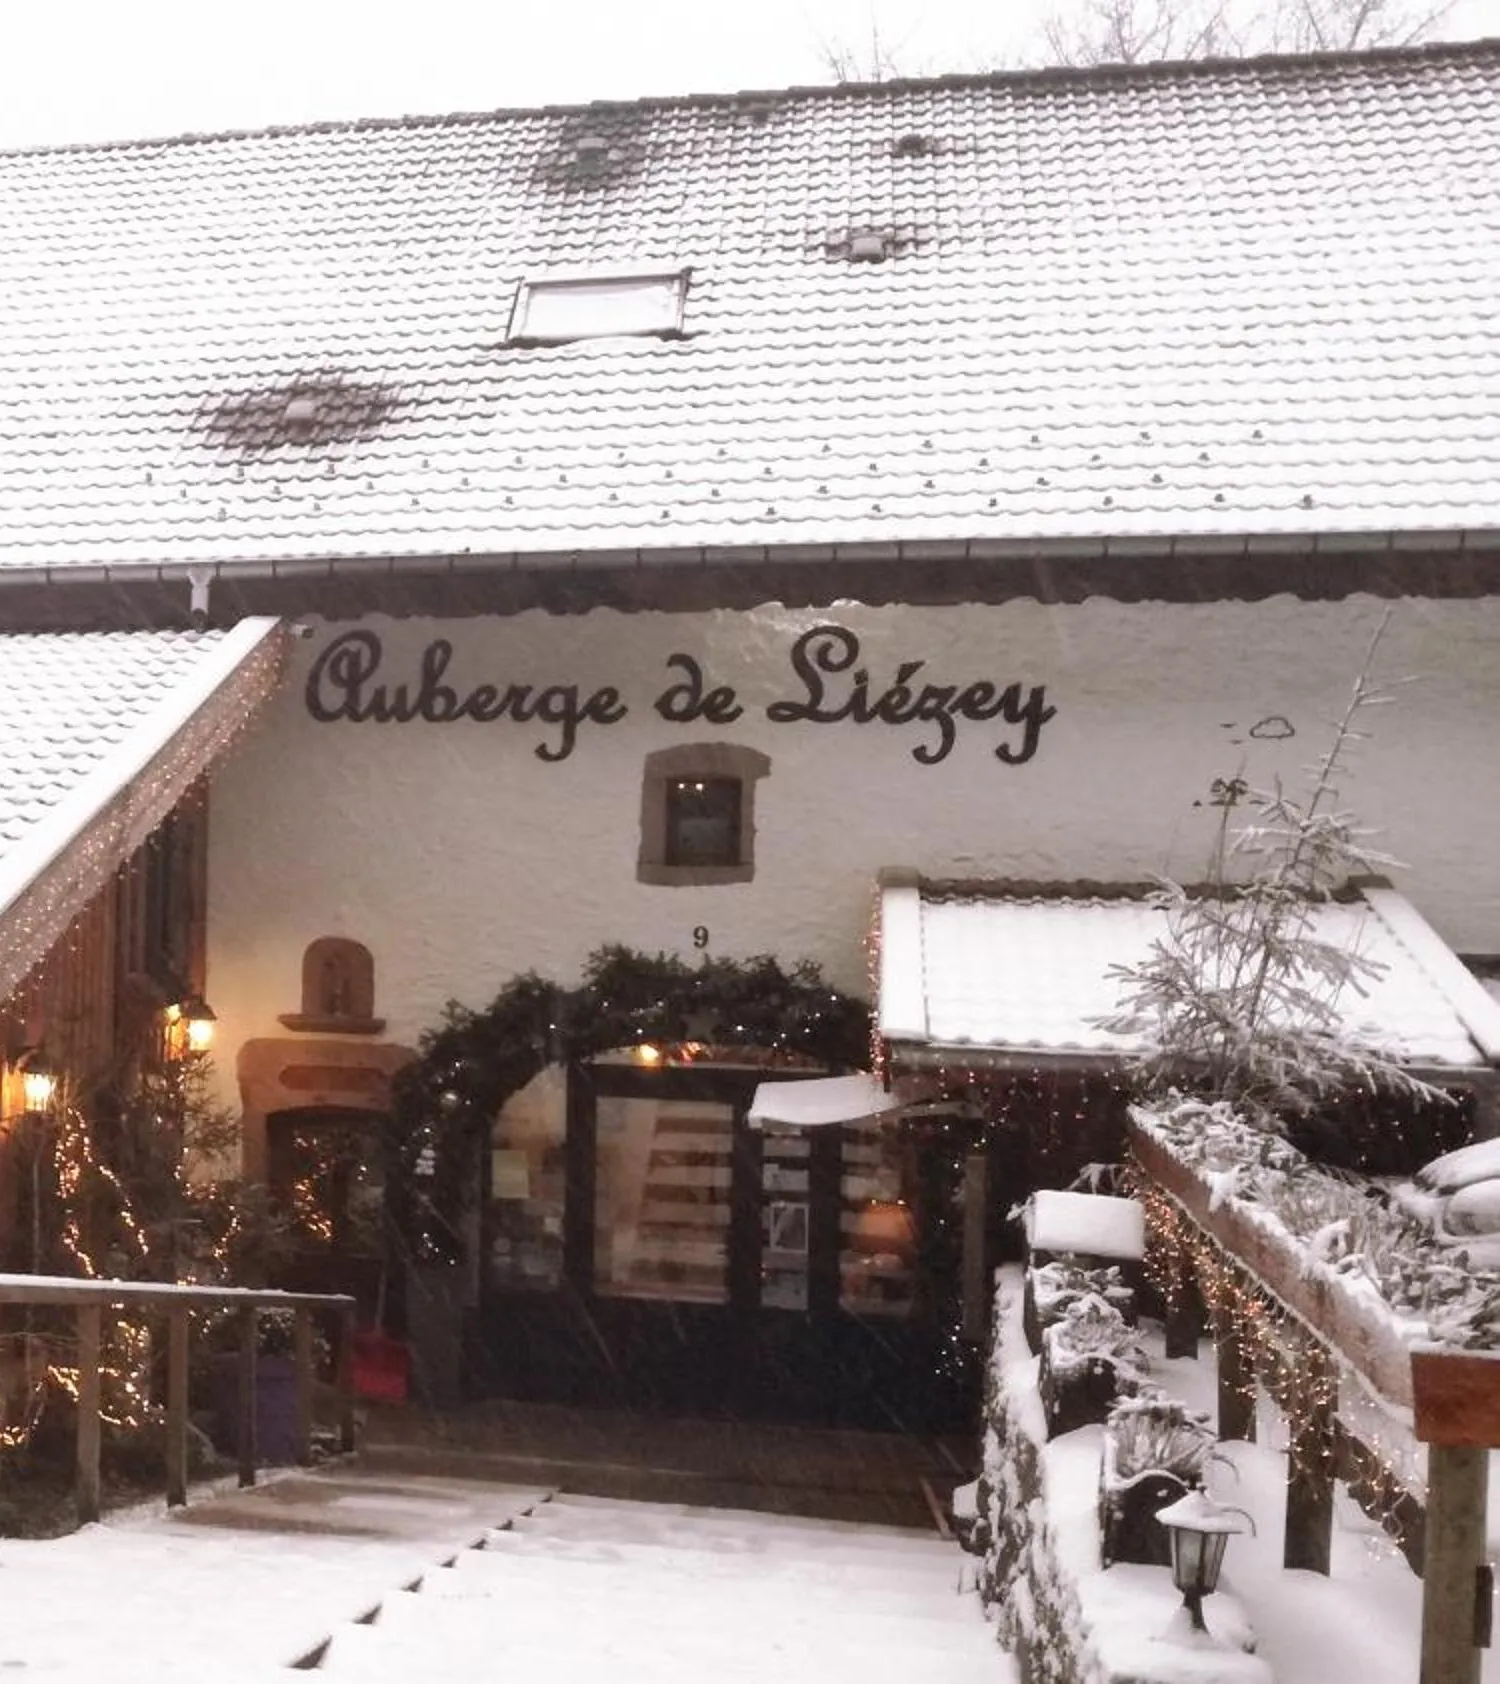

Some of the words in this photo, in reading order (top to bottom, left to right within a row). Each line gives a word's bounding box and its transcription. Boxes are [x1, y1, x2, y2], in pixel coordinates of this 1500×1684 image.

[304, 629, 628, 762] Auberge
[653, 653, 743, 725] de
[766, 625, 1057, 765] Liézey
[693, 926, 710, 950] 9
